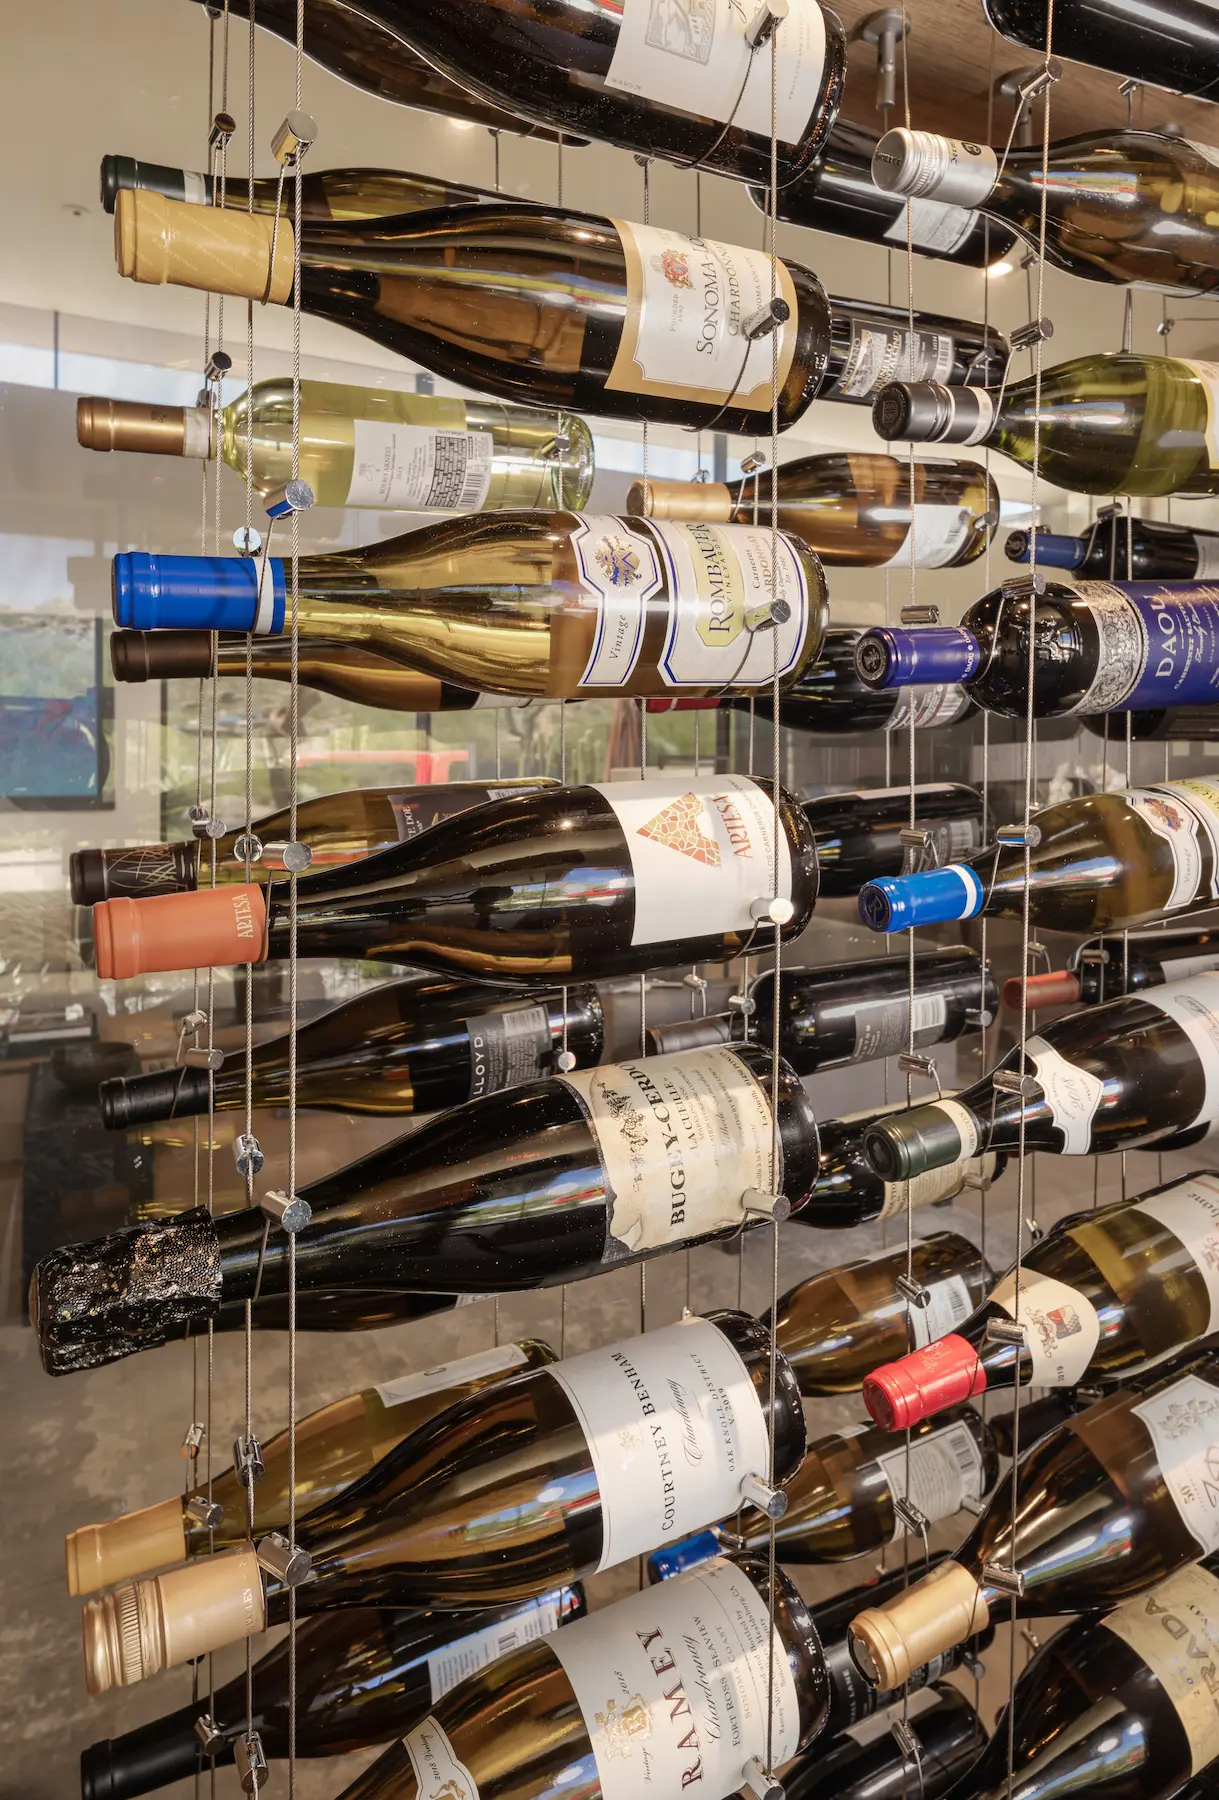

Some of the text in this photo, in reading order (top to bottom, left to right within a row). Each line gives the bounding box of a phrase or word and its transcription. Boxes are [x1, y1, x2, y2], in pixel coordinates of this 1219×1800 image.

[688, 234, 719, 355] SONOMA-LO
[838, 338, 860, 388] ARGIANO
[686, 523, 734, 632] ROMBAUER
[712, 538, 732, 603] VINEYARDS
[746, 549, 760, 589] Carneros
[609, 615, 626, 660] Vintage
[964, 652, 974, 672] DAOU
[1143, 595, 1177, 678] DAOU
[1174, 637, 1194, 690] CABERNET
[1193, 625, 1208, 663] Family
[402, 804, 414, 825] DOE
[713, 795, 753, 859] ARTESA
[1183, 848, 1192, 883] Vintage
[232, 893, 254, 938] ARTESA
[473, 1037, 485, 1094] LLOYD
[616, 1062, 688, 1227] BUGEY-CERDO
[665, 1377, 704, 1467] Chardonnay
[690, 1353, 736, 1472] OAK KNOLL DISTRICT
[718, 1387, 732, 1411] 2019
[611, 1352, 676, 1531] COURTNEY BENHAM
[742, 1620, 757, 1652] Bottled
[682, 1634, 721, 1744] Chardonnay
[692, 1615, 740, 1748] FORT ROSS SEAVIEW
[715, 1625, 751, 1720] SONOMA COAST
[842, 1669, 856, 1698] LANE
[636, 1626, 704, 1791] RAMEY
[420, 1733, 441, 1781] 2018 Vintage
